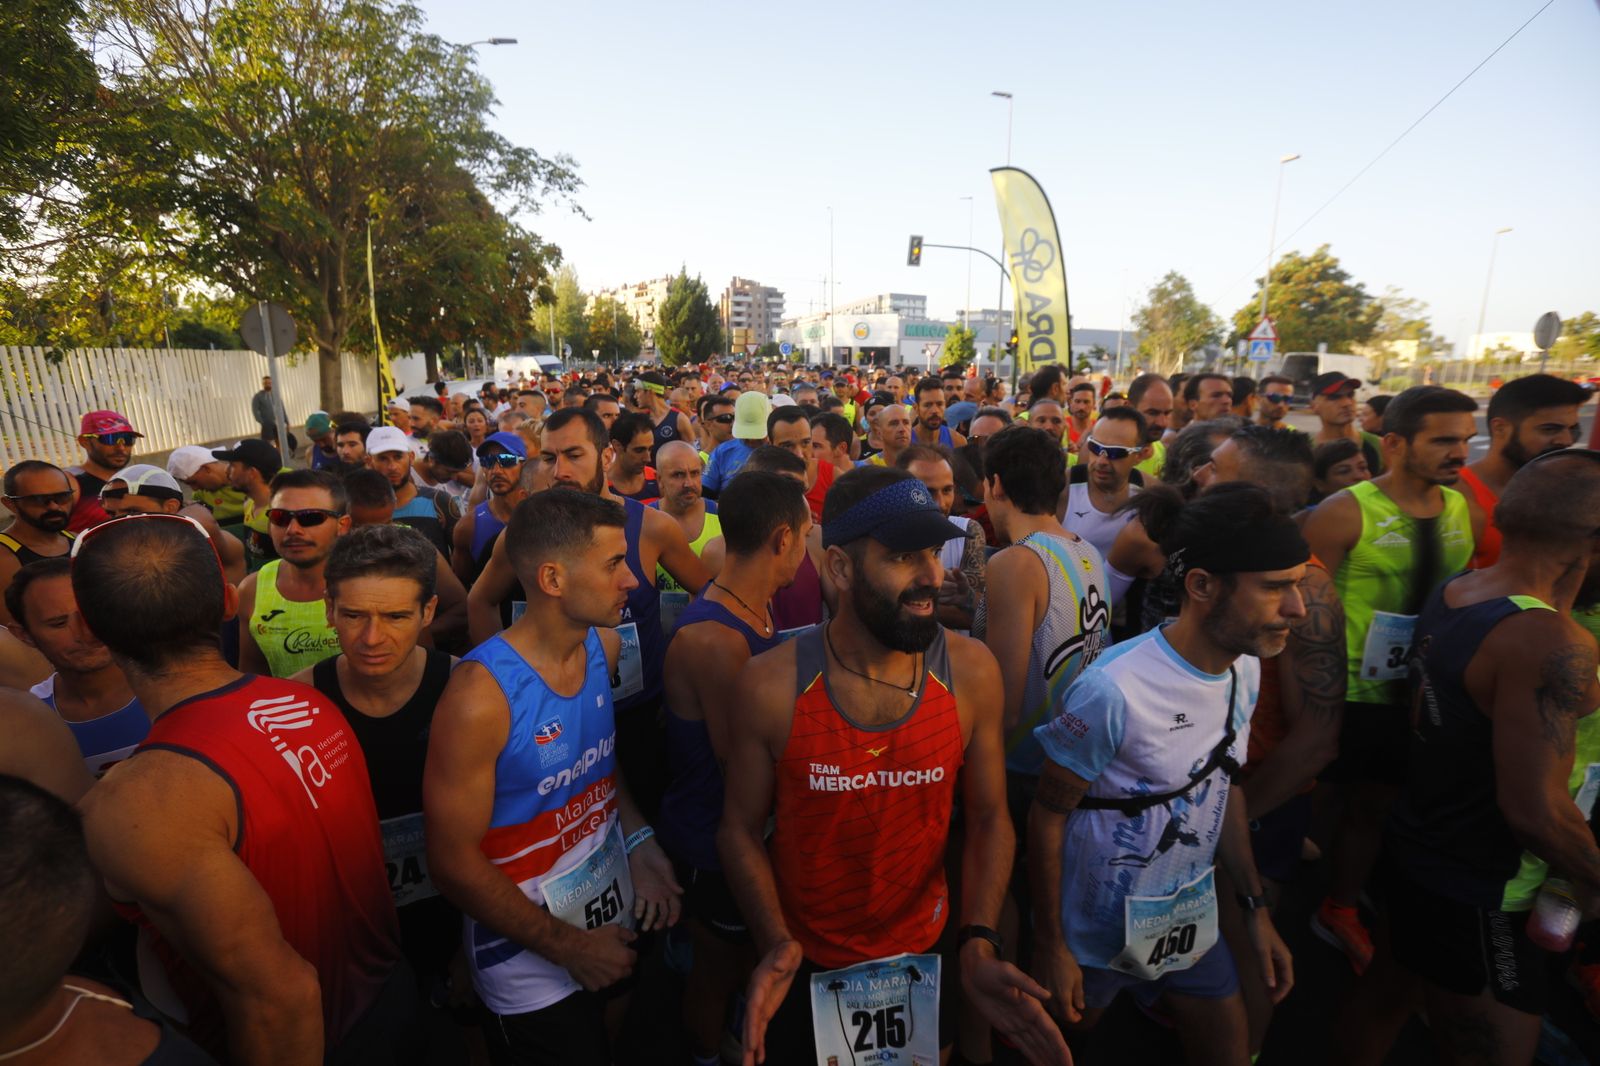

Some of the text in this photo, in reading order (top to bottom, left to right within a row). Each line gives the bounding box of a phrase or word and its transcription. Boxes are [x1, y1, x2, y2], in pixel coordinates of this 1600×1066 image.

[809, 763, 840, 774] TEAM
[809, 767, 945, 792] MERCATUCHO
[555, 880, 593, 912] MEDIA
[584, 877, 625, 930] 551
[818, 980, 864, 993] MDIA
[852, 1005, 907, 1053] 215
